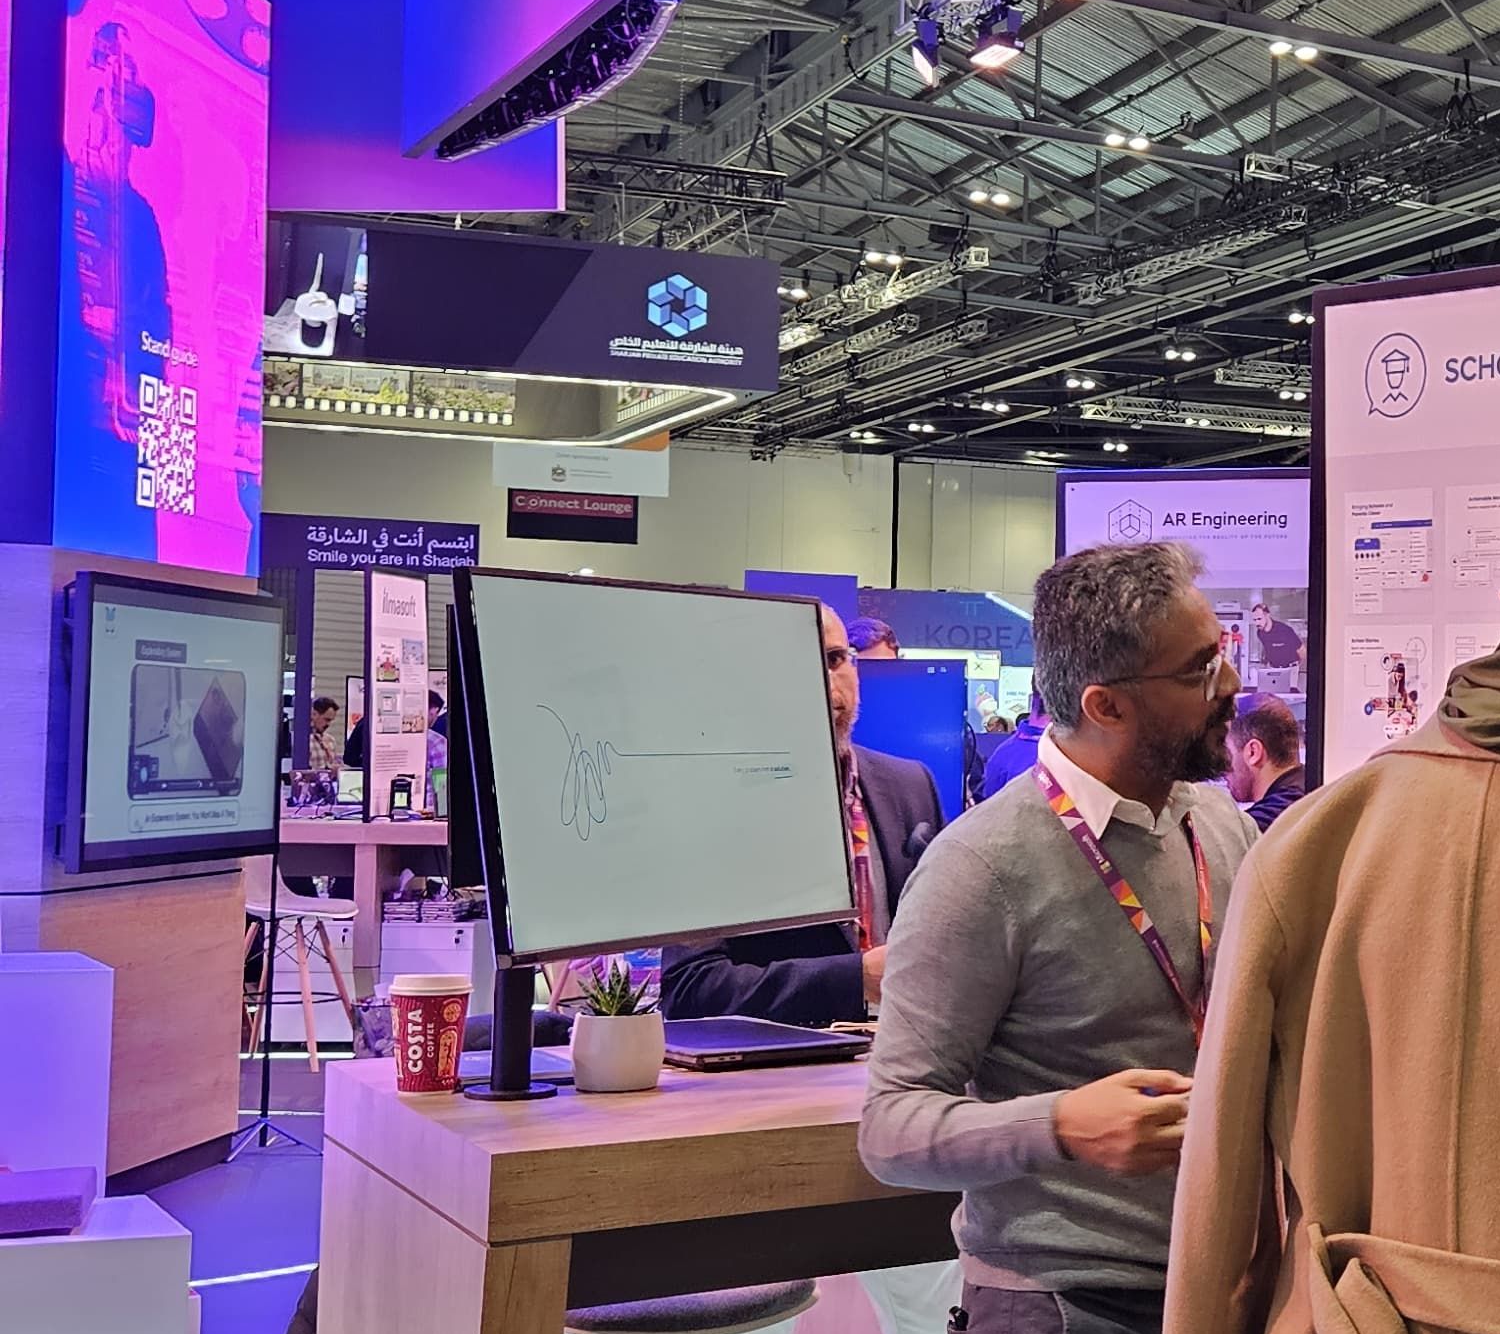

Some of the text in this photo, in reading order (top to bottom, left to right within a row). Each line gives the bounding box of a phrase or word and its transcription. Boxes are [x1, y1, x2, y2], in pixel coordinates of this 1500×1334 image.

[515, 495, 633, 515] Connect Lounge
[1162, 510, 1288, 529] AR Engineering
[307, 526, 475, 553] ابتسم أنت في الشارقة
[307, 548, 476, 568] Smile you are in Sharjah
[408, 1008, 425, 1074] COSTA
